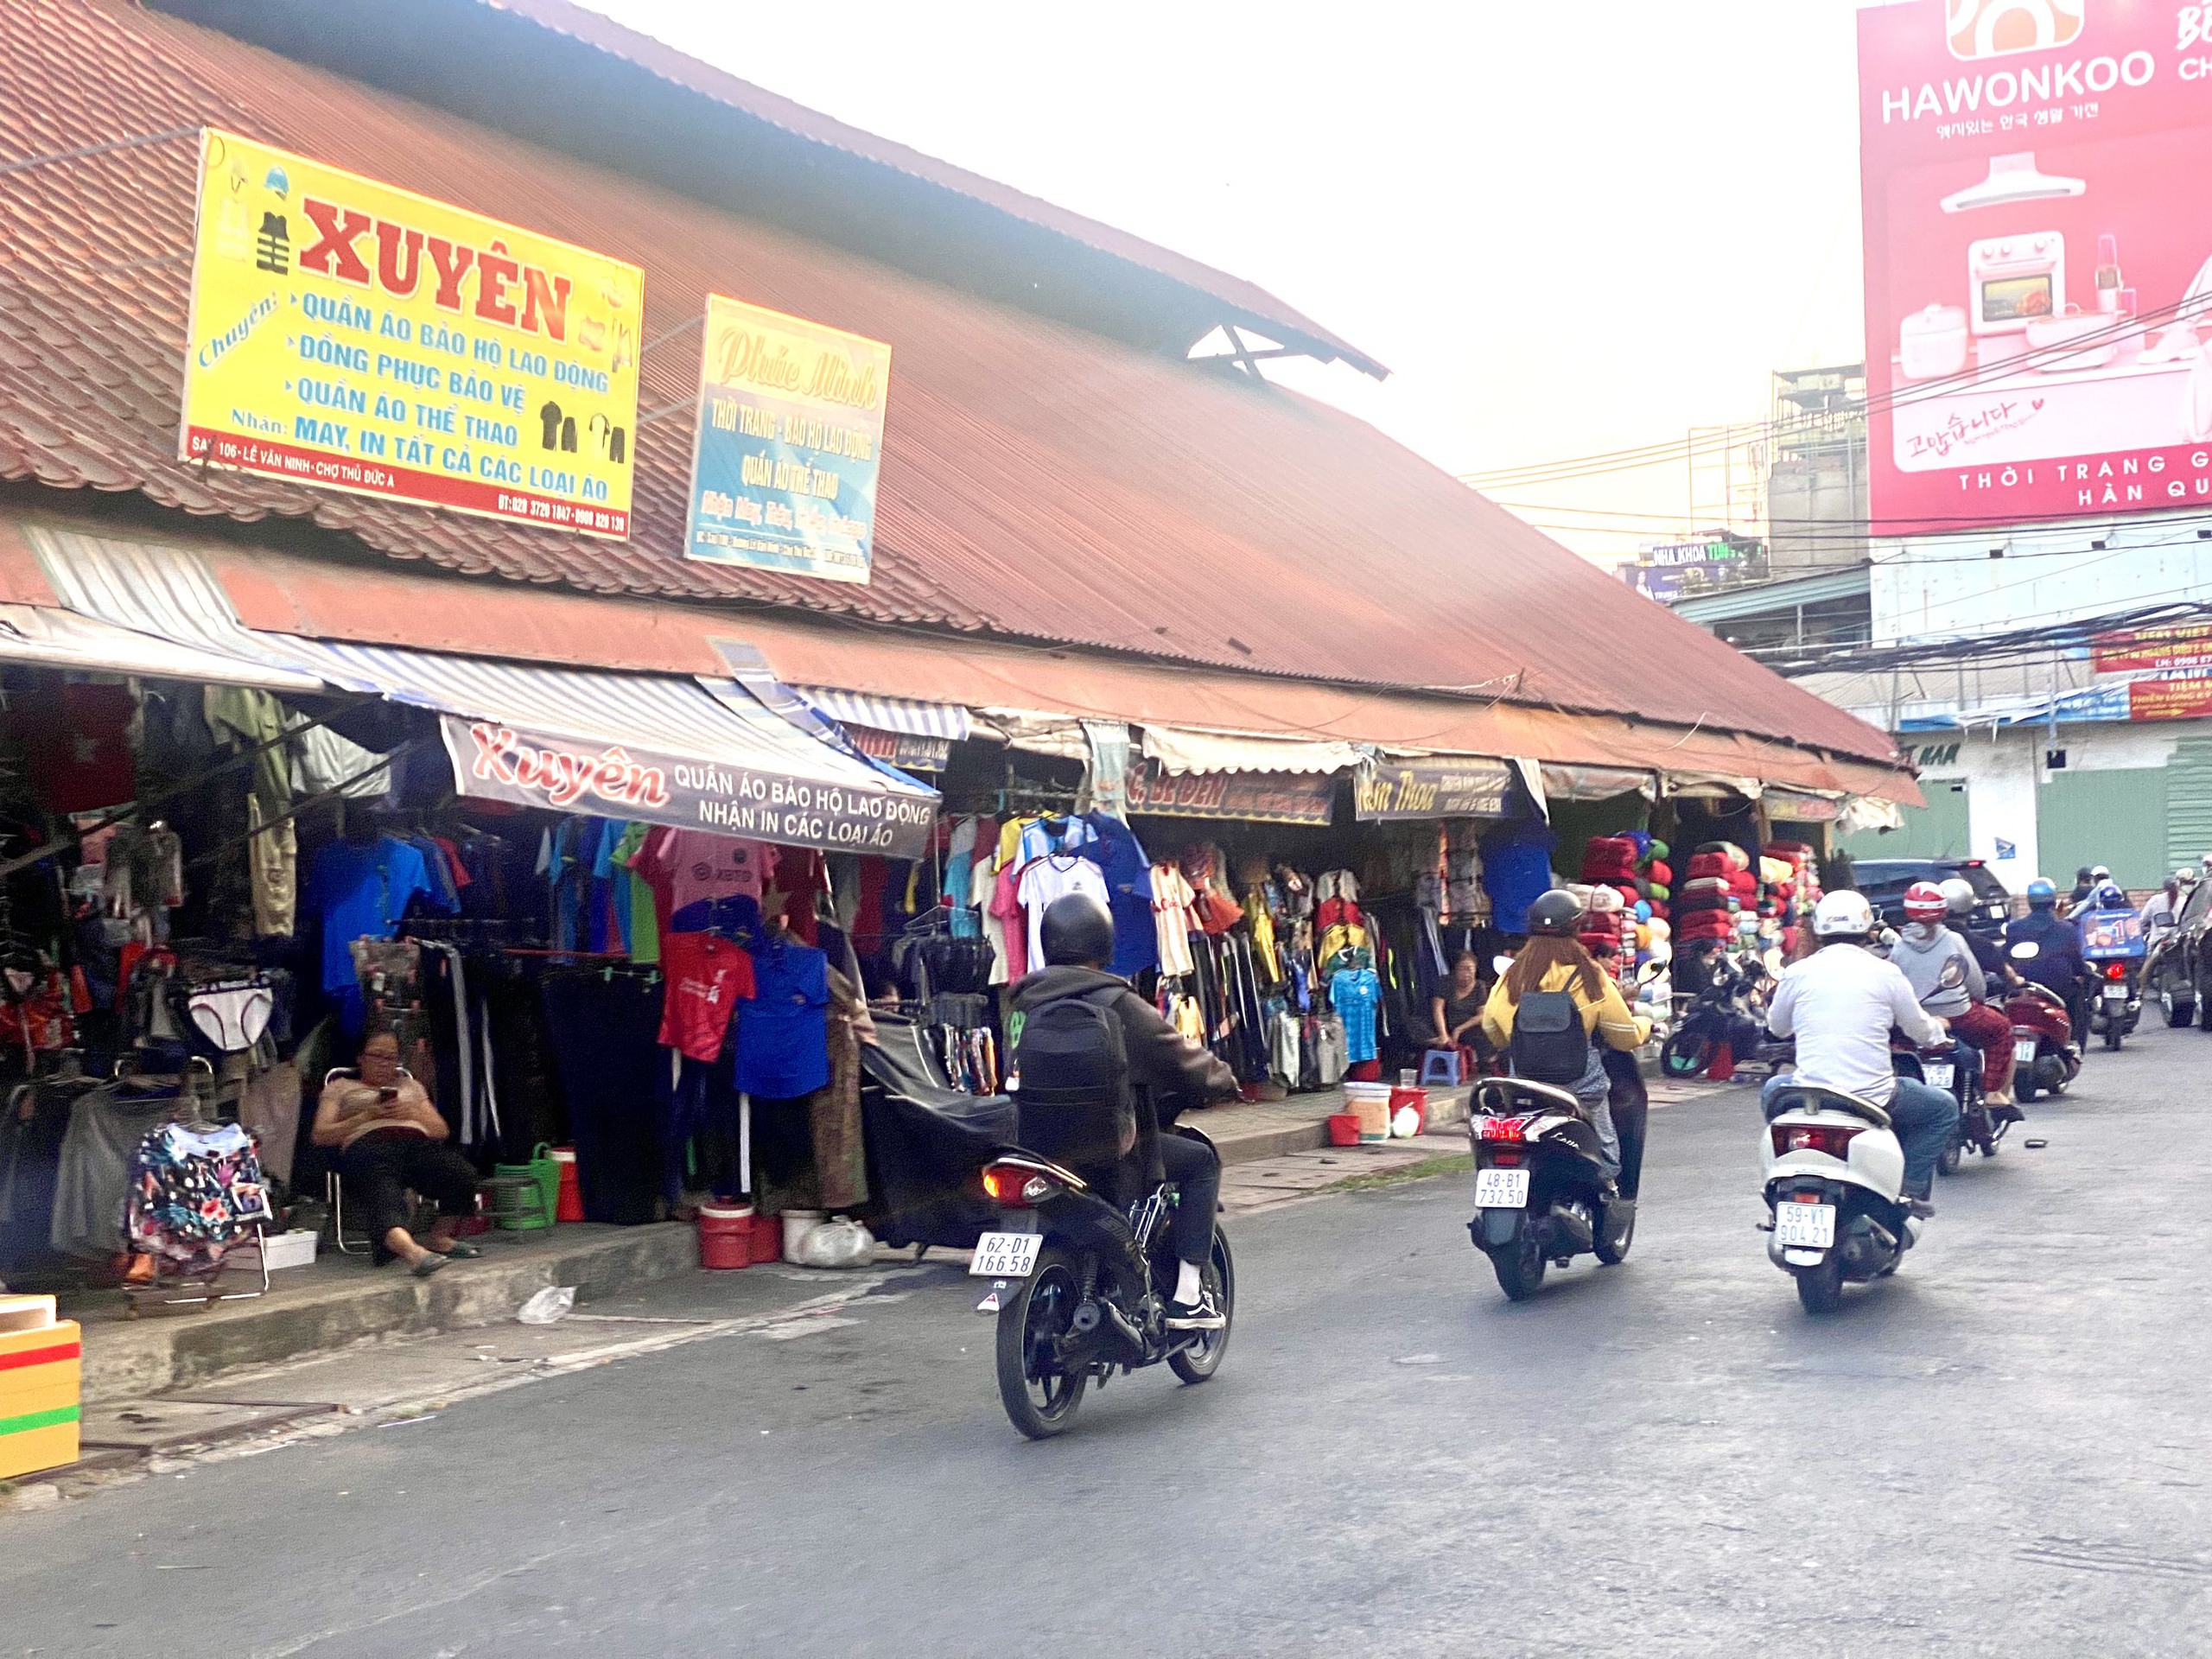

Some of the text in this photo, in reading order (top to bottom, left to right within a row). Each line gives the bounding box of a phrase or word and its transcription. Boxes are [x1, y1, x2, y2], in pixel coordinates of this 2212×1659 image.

[1882, 51, 2155, 124] HAWONKOO
[299, 197, 572, 342] XUYÊN
[303, 293, 608, 393] QUẦN ÁO BẢO HỘ LAO ĐỘNG
[300, 333, 525, 415] ĐỒNG PHỤC BẢO VỆ
[802, 351, 878, 411] Minh
[298, 378, 518, 447] QUẦN ÁO THỂ THAO
[740, 404, 777, 441] TRANG
[823, 424, 844, 455] LAO
[341, 463, 361, 481] THỦ
[387, 474, 395, 487] A
[361, 430, 385, 457] IN
[395, 435, 435, 465] TẤT
[442, 444, 472, 474] CẢ
[480, 454, 522, 484] CÁC
[530, 466, 575, 499] LOẠI
[582, 474, 608, 501] ÁO
[813, 468, 840, 501] THAO
[1960, 465, 2033, 490] THỜI
[2058, 455, 2165, 481] TRANG
[2078, 483, 2143, 506] HÀN
[470, 722, 671, 808] Xuyên
[675, 761, 930, 826] QUẦN ÁO BẢO HỘ LAO ĐỘNG
[699, 797, 893, 849] NHẬN IN CÁC LOẠI ÁO
[1487, 1173, 1520, 1187] 48-B1
[1787, 1206, 1824, 1225] 59-V1
[976, 1255, 1031, 1273] 166.58
[987, 1236, 1030, 1254] 62-D1
